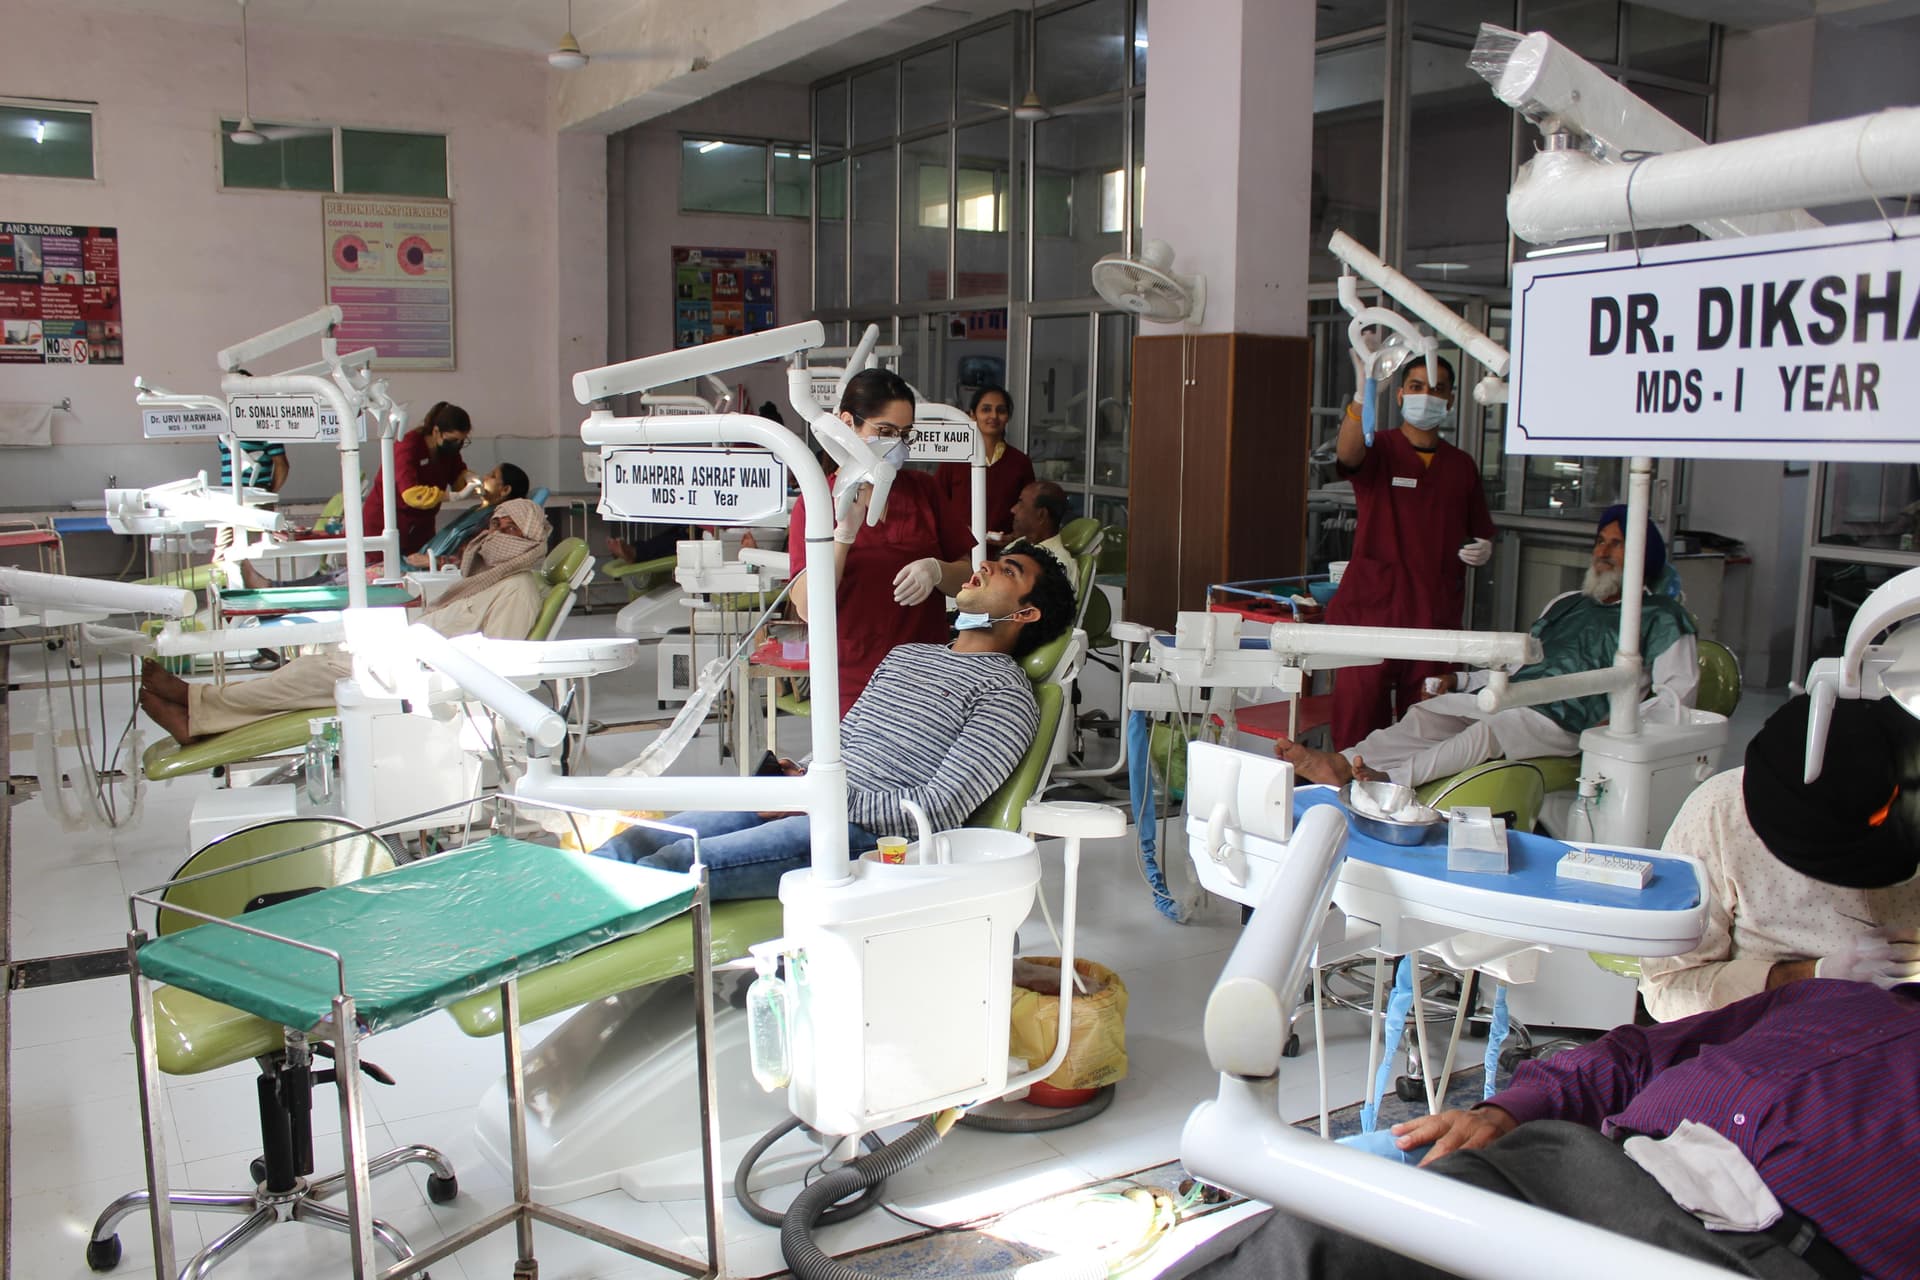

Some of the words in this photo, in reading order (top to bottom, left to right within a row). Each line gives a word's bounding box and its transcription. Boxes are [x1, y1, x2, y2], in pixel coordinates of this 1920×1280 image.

[6, 224, 27, 233] AND
[28, 225, 73, 236] SMOKING
[1589, 292, 1674, 356] DR.
[47, 338, 60, 353] NO
[47, 356, 73, 364] SMOKING
[1636, 368, 1702, 413] MDS
[1778, 363, 1880, 412] YEAR
[235, 406, 247, 418] Dr.
[249, 406, 278, 418] SONALI
[281, 406, 315, 418] SHARMA
[150, 415, 160, 424] Dr.
[163, 415, 181, 423] URVI
[183, 413, 222, 423] MARWAHA
[287, 420, 300, 429] Year
[944, 431, 969, 443] KAUR
[934, 443, 949, 453] Year
[615, 464, 629, 484] Dr.
[632, 464, 685, 486] MAHPARA
[691, 466, 736, 487] ASHRAF
[740, 468, 771, 489] WANI
[652, 488, 676, 505] MDS
[714, 490, 739, 507] Year
